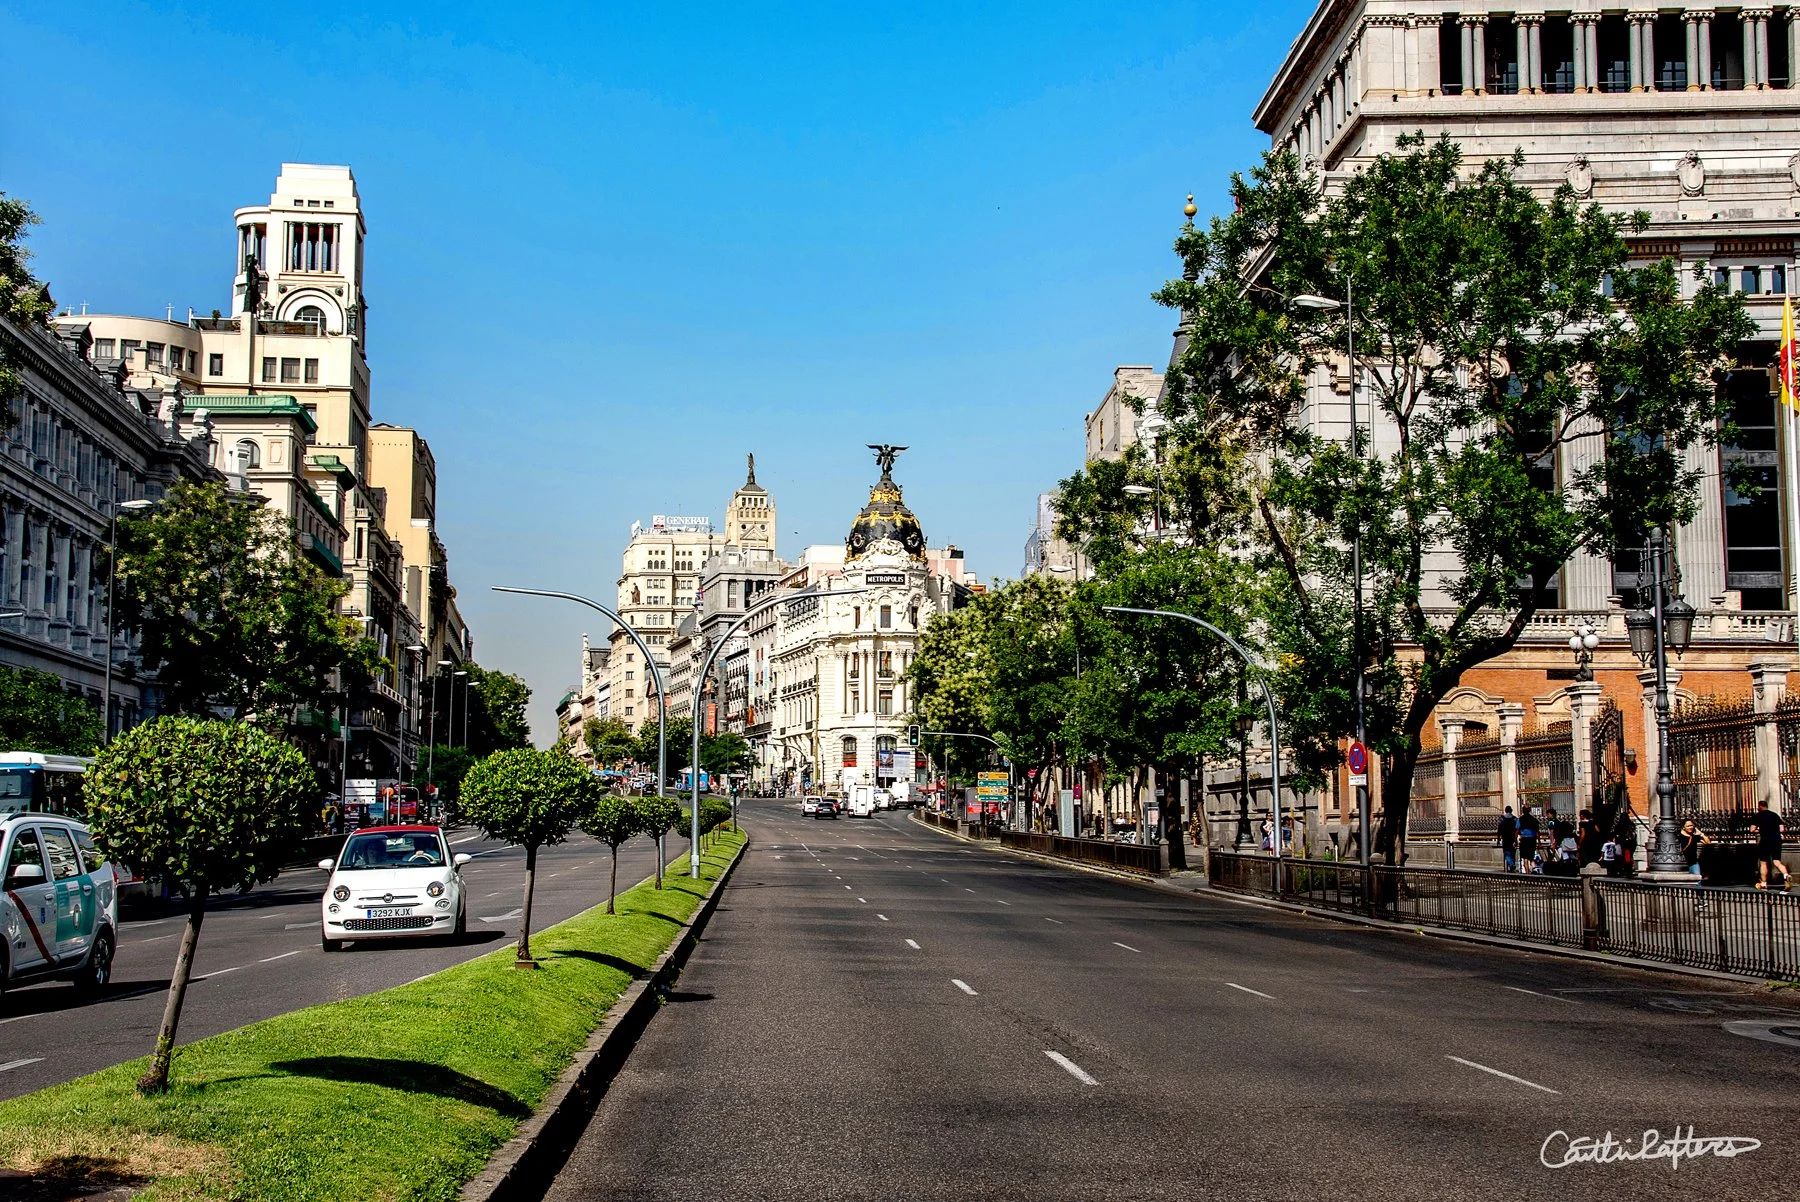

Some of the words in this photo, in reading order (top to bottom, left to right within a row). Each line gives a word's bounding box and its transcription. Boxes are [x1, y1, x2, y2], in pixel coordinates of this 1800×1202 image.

[666, 516, 709, 525] GENERALI
[867, 575, 904, 583] METROPOLIS
[372, 909, 393, 918] 3292
[394, 908, 411, 917] KJX
